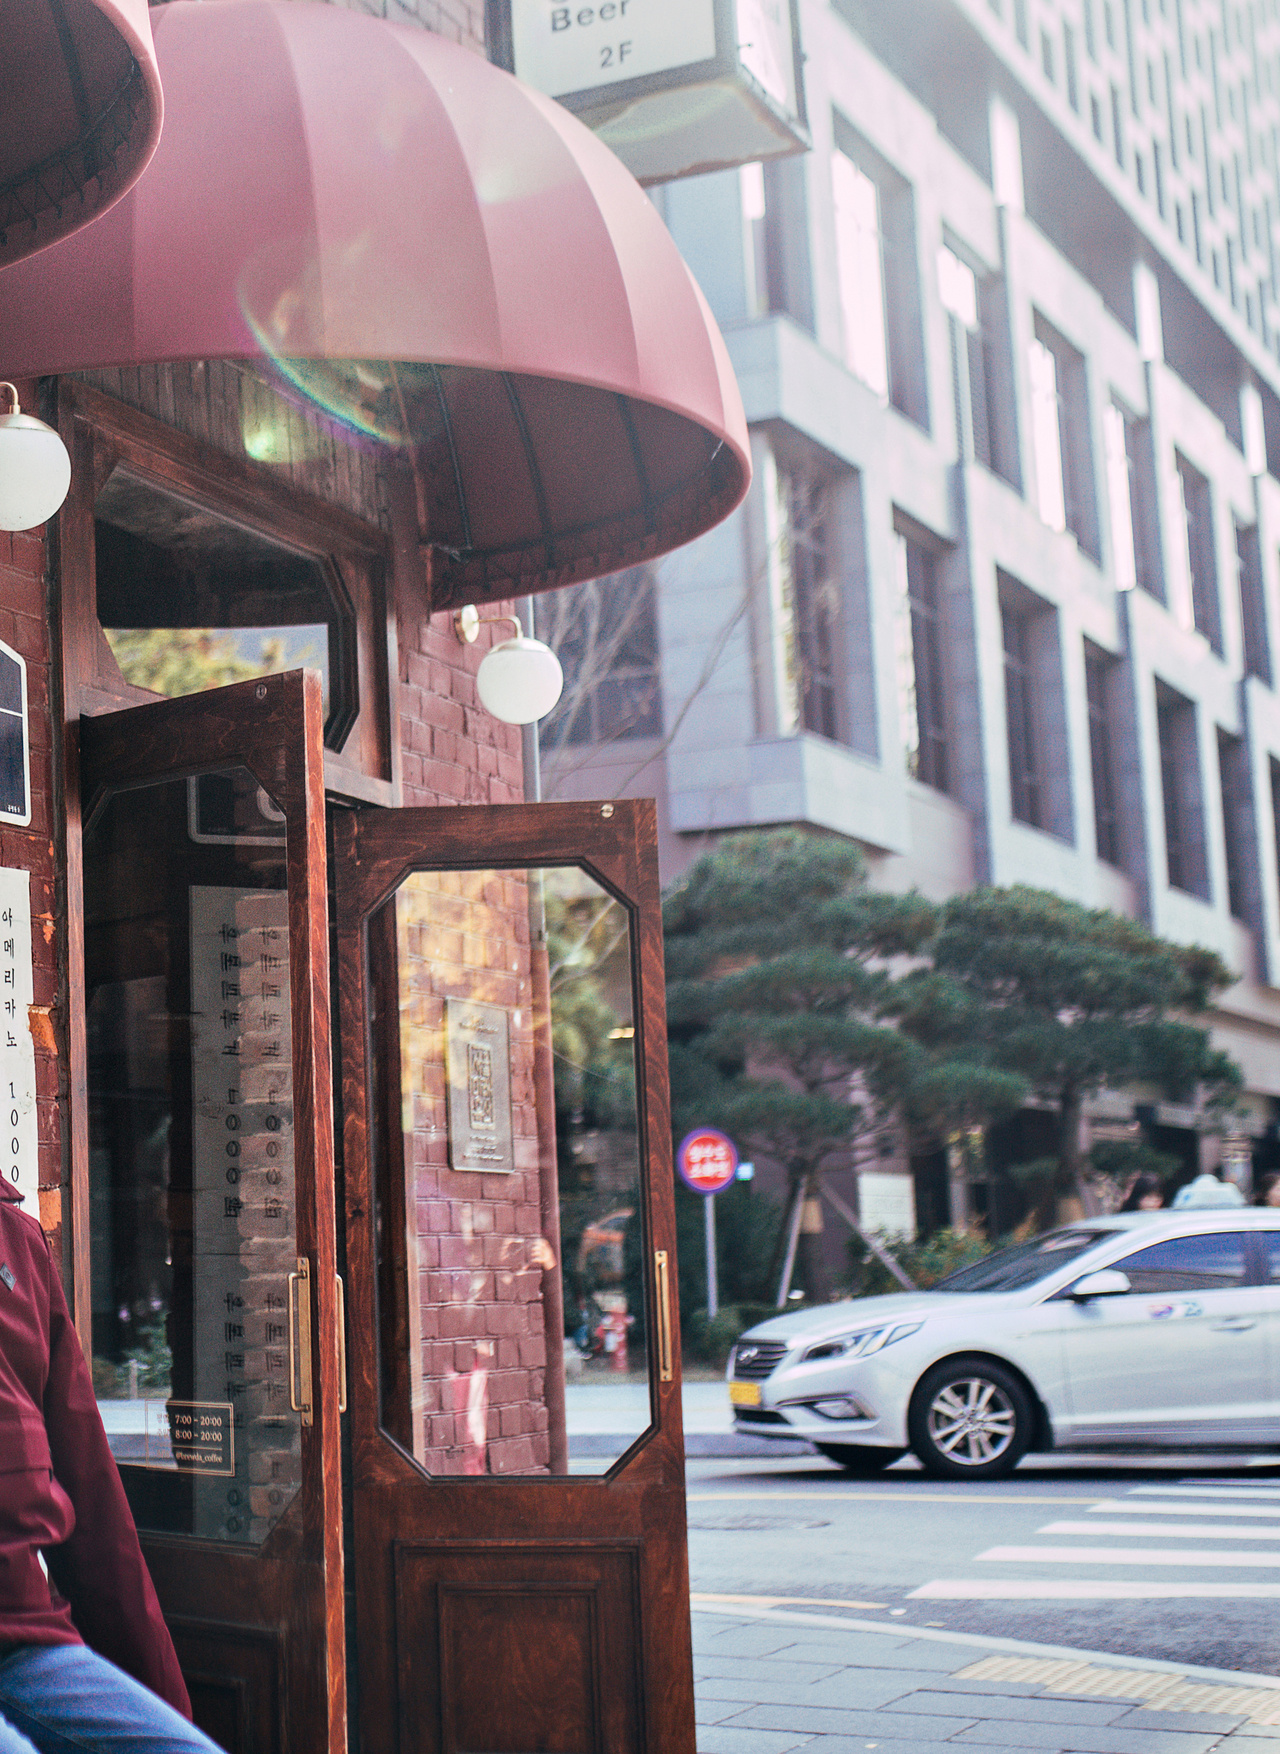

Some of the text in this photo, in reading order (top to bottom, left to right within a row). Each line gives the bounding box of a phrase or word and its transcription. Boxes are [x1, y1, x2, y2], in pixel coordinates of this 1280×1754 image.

[550, 0, 631, 32] Beer
[600, 40, 632, 69] 2F
[8, 1081, 20, 1208] 1000
[175, 1413, 193, 1425] 7:00
[200, 1415, 222, 1427] 20:00
[175, 1429, 193, 1441] 8:00
[200, 1431, 223, 1442] 20:00
[175, 1450, 223, 1464] @brewda_coffee
